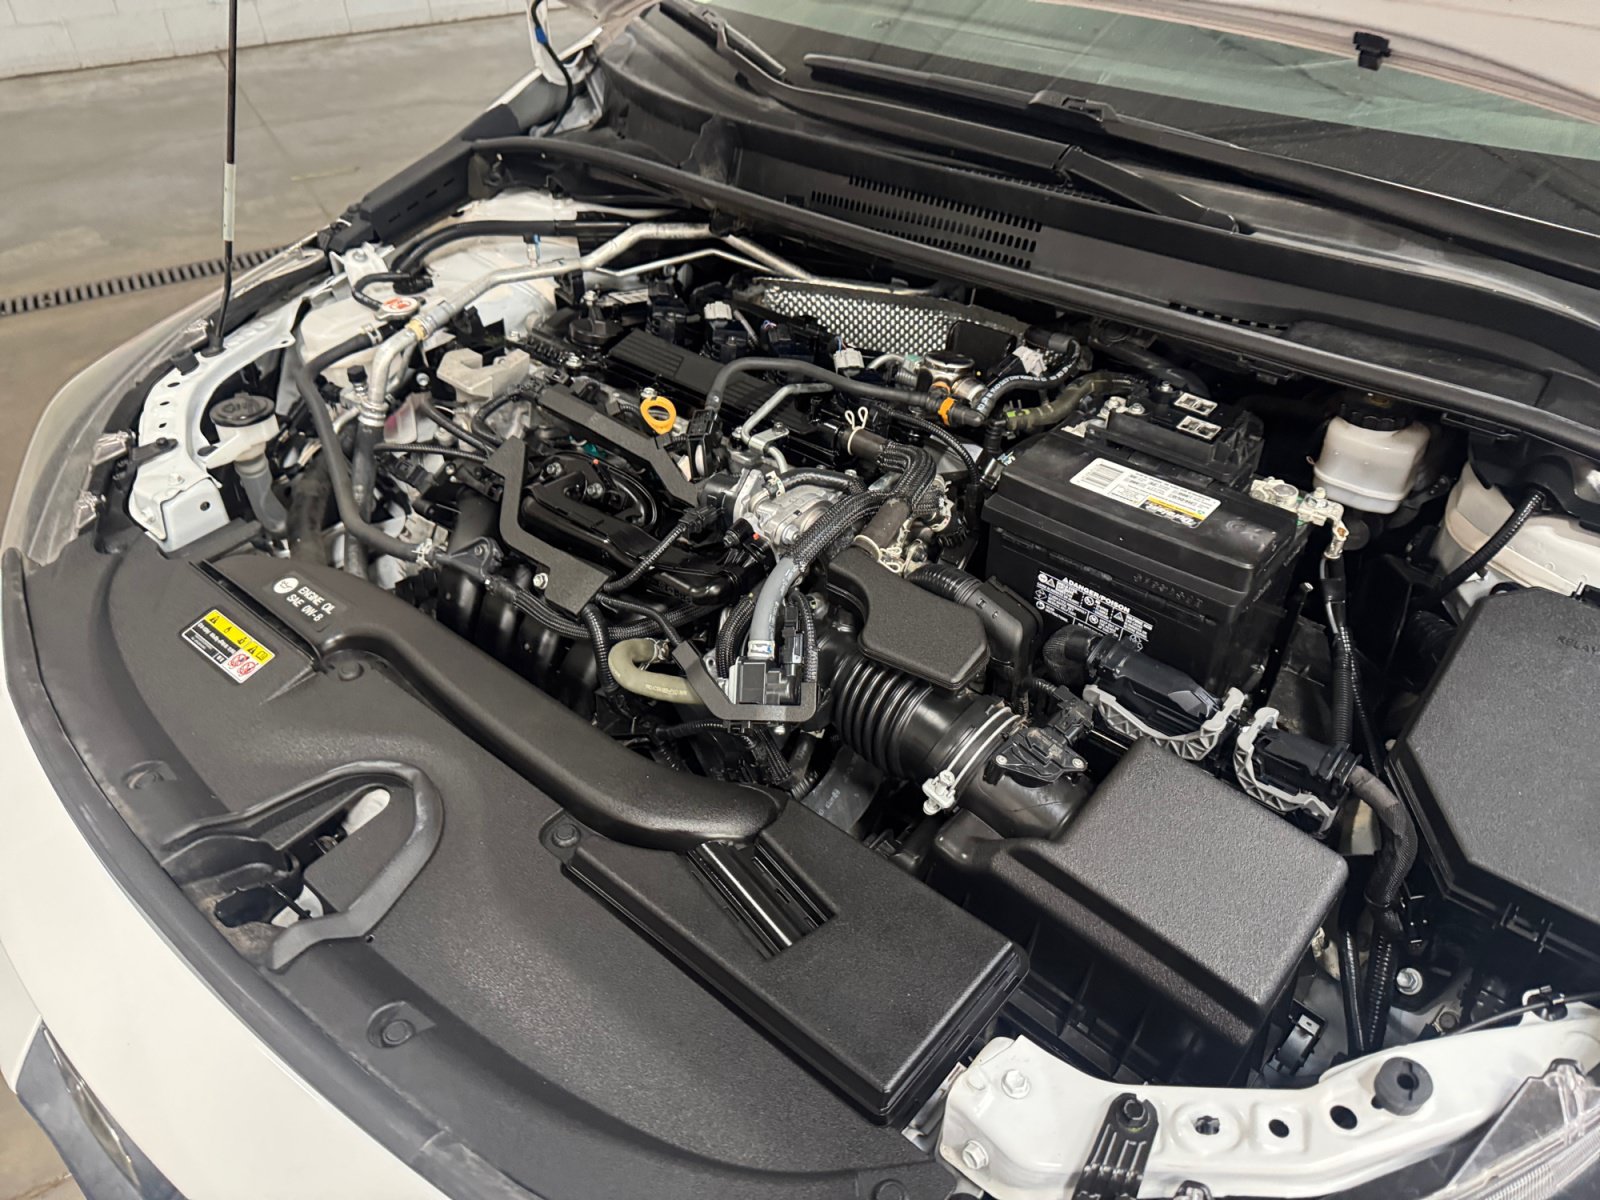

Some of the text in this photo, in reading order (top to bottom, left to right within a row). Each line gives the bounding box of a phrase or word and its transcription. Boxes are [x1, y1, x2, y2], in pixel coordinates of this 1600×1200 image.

[286, 593, 305, 608] SAE
[298, 586, 336, 615] ENGINE OIL
